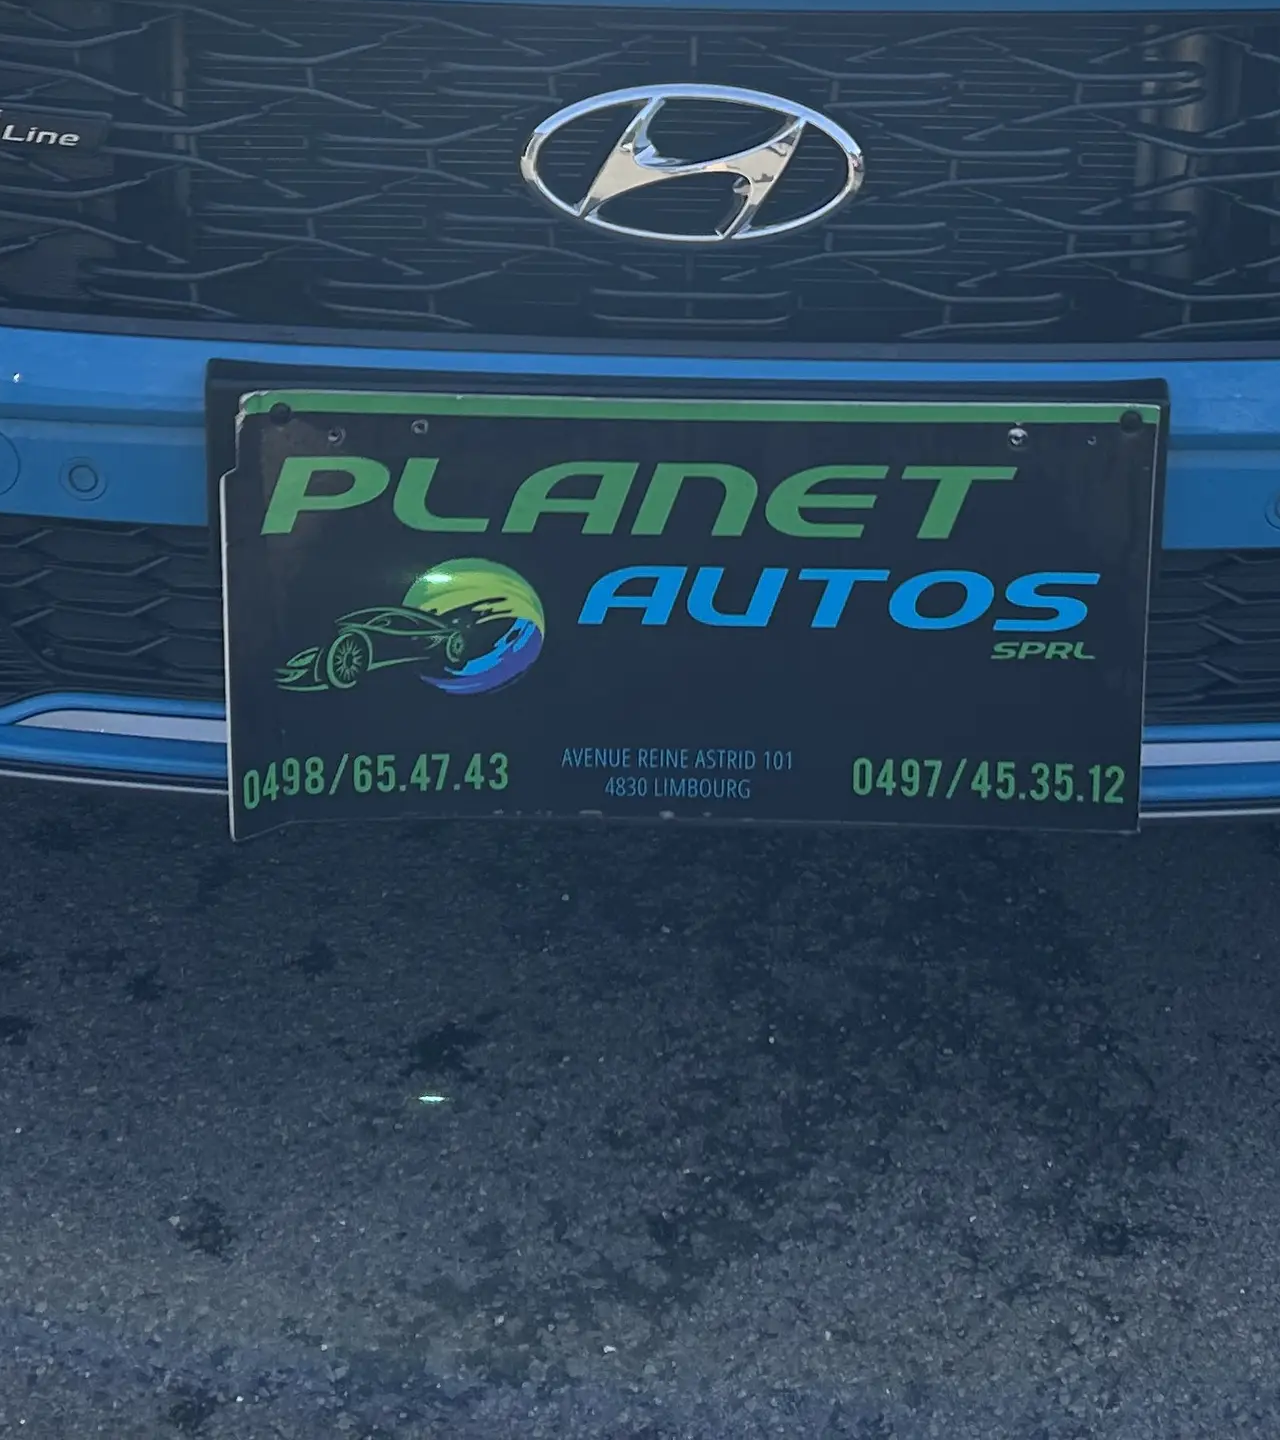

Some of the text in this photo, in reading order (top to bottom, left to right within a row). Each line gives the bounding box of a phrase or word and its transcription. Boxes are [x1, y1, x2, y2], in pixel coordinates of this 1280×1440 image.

[2, 124, 80, 147] Line
[260, 455, 1018, 539] PLANET
[577, 565, 1102, 632] AUTOS
[990, 641, 1097, 661] SPRL
[561, 747, 793, 770] AVENUE REINE ASTRID 101
[243, 752, 509, 810] 0498/65.47.43
[604, 776, 751, 799] 4830 LIMBOURG
[852, 757, 1126, 804] 0497/45.35.12
